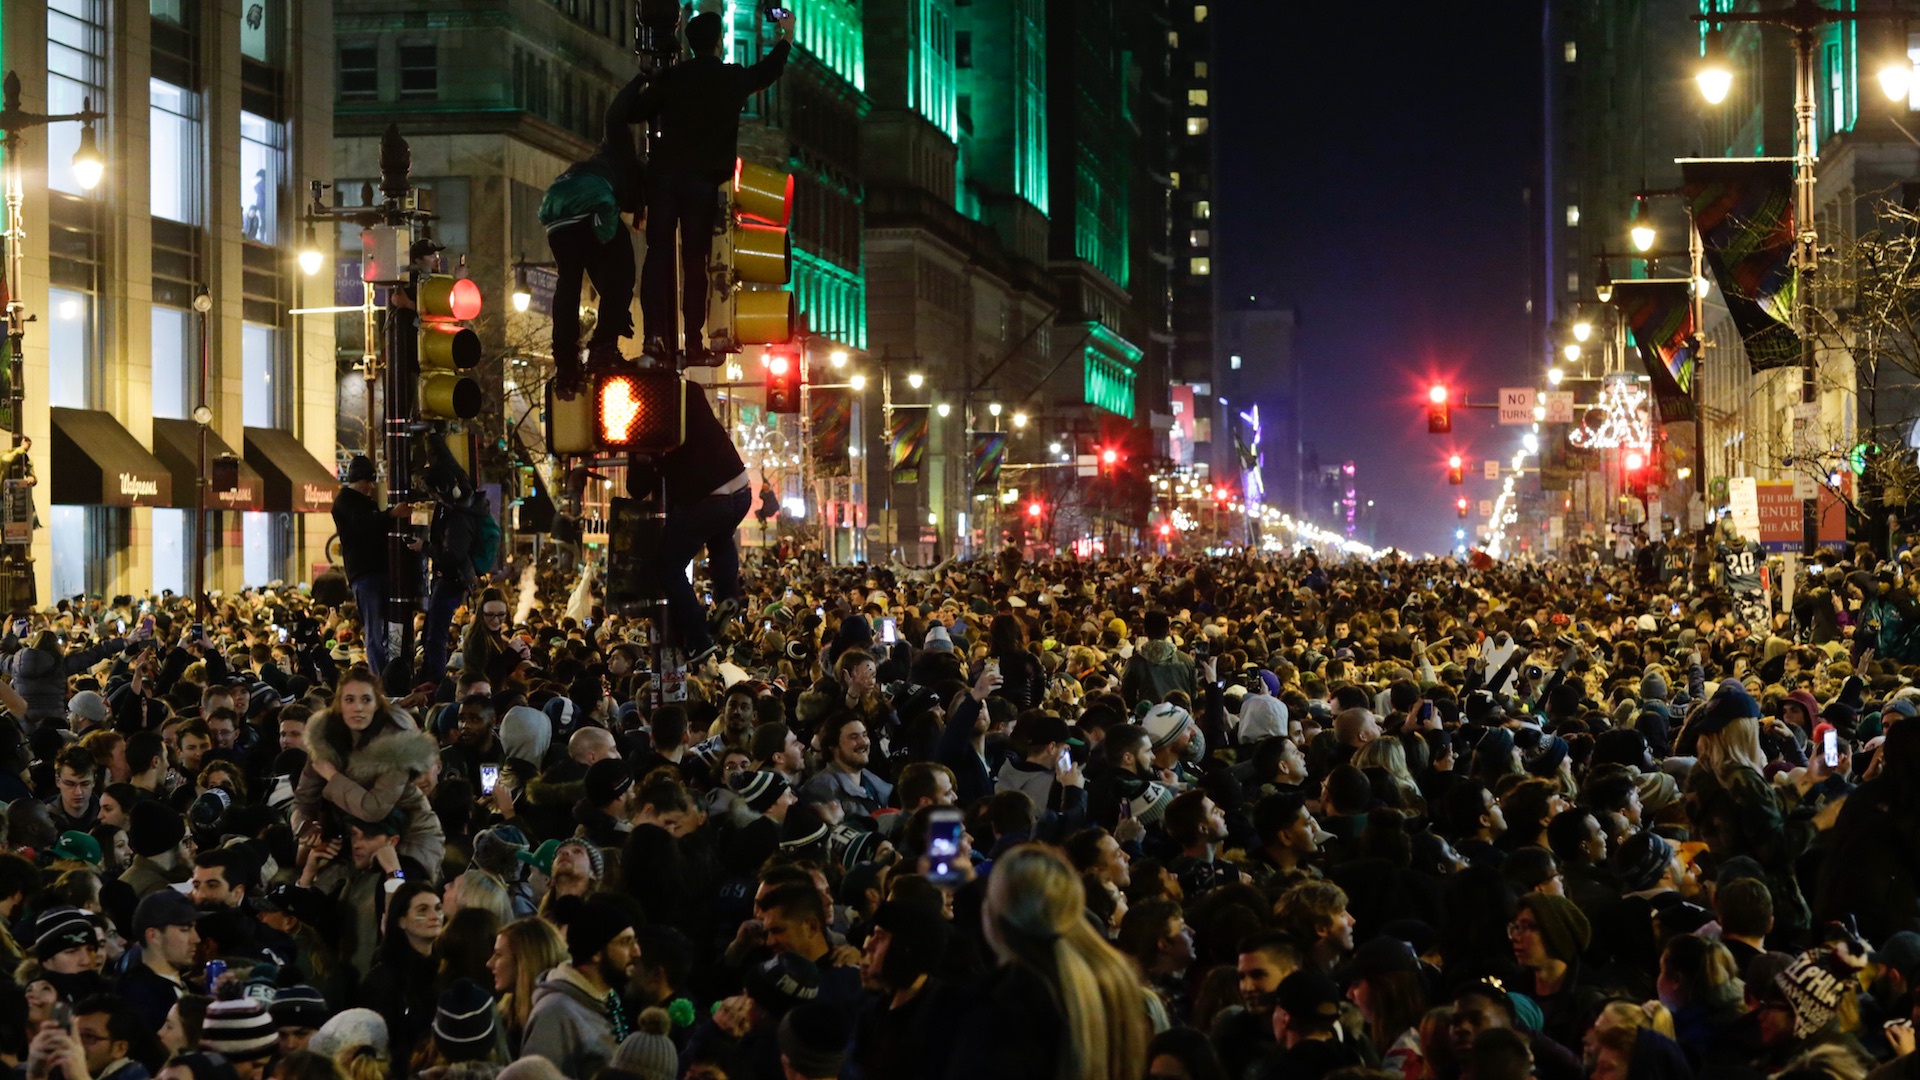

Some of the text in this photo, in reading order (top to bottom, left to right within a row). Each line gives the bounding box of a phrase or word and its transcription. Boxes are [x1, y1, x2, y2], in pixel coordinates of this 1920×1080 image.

[1508, 394, 1526, 405] NO
[1501, 410, 1533, 420] TURNS
[119, 472, 158, 502] Walgreens
[304, 483, 334, 509] Walgreens
[1759, 506, 1798, 518] ENUE
